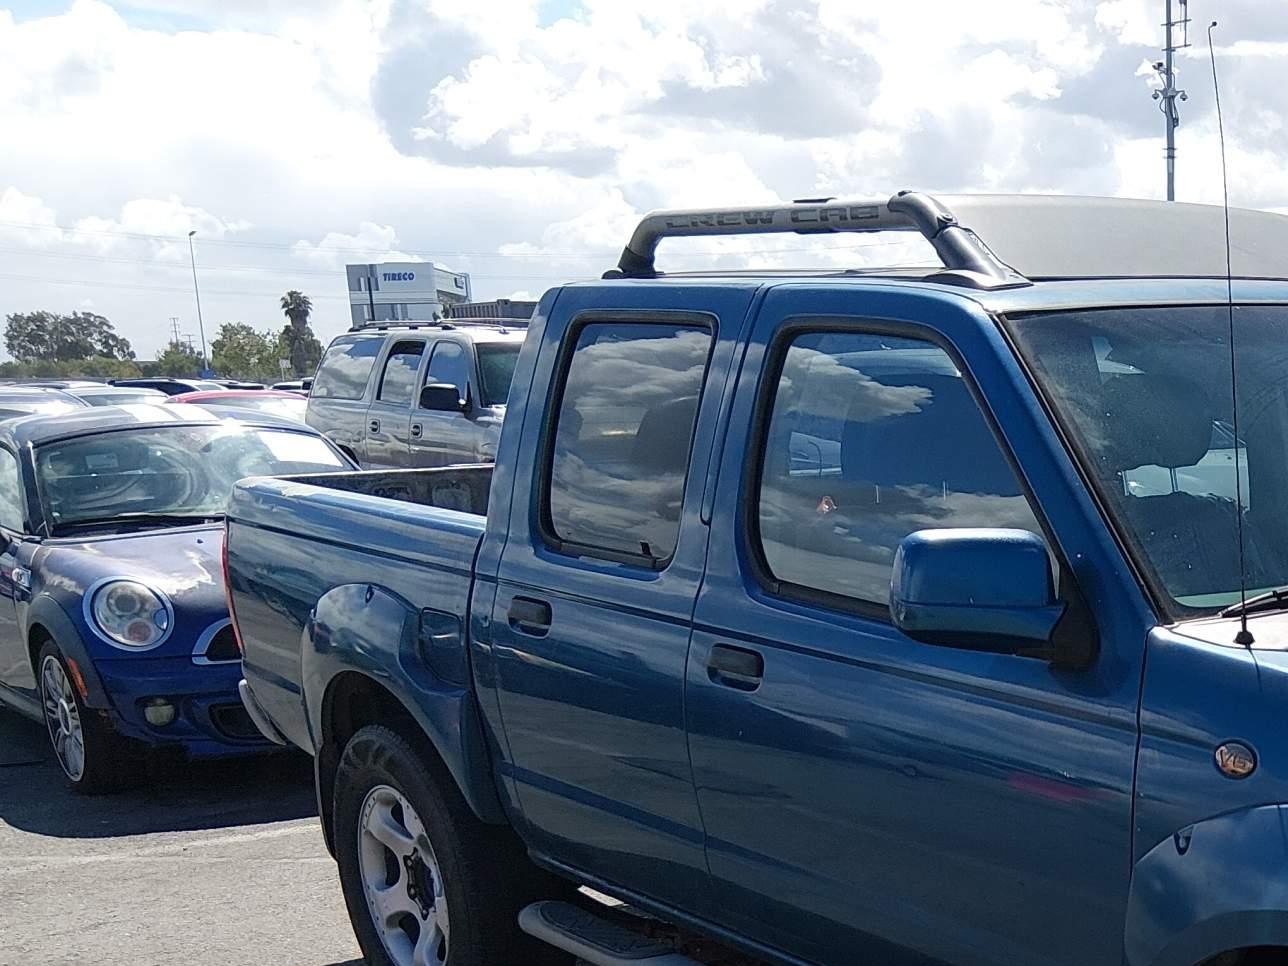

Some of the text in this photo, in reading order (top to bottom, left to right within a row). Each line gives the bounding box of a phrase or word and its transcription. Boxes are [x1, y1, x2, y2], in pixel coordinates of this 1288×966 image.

[666, 205, 879, 228] CREW CAB
[383, 272, 414, 281] TIRECO
